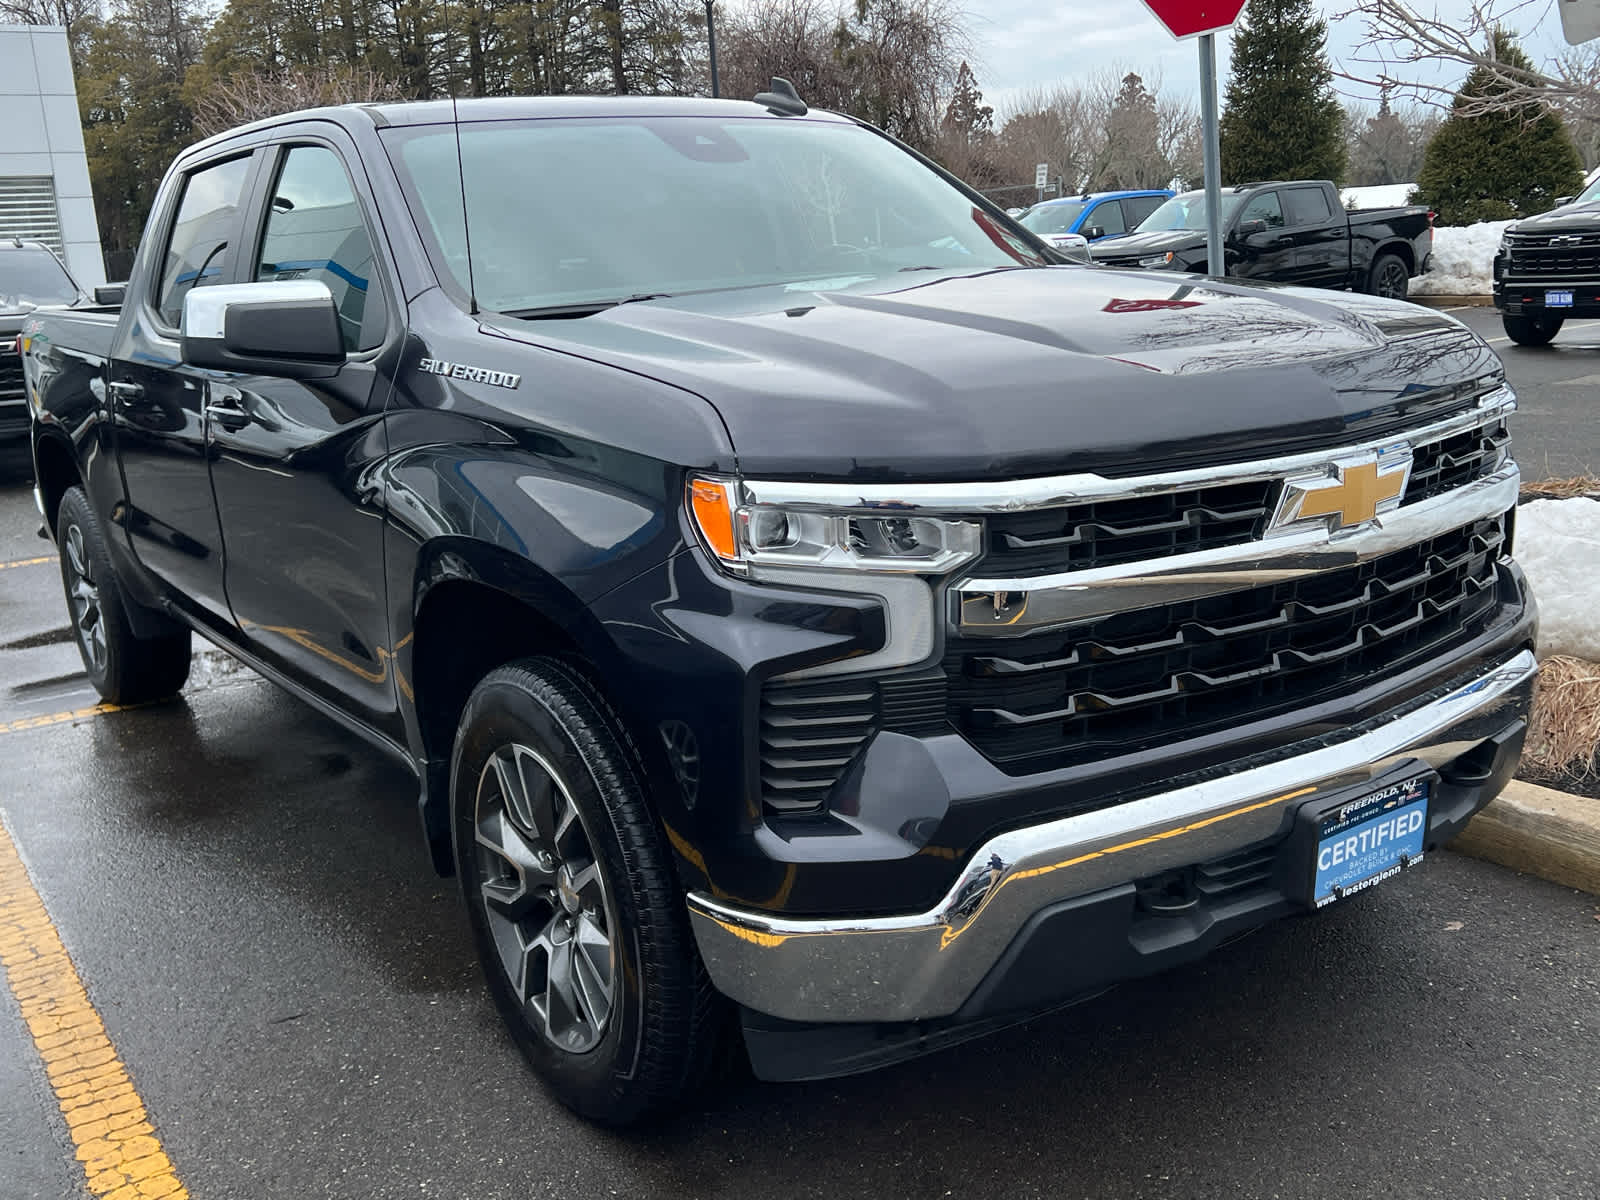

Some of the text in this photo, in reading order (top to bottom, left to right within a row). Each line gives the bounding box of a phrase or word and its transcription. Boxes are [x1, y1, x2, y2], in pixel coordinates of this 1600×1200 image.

[418, 358, 521, 389] SILVERADO
[1318, 810, 1423, 872] CERTIFIED
[1349, 847, 1388, 870] BACKED BY
